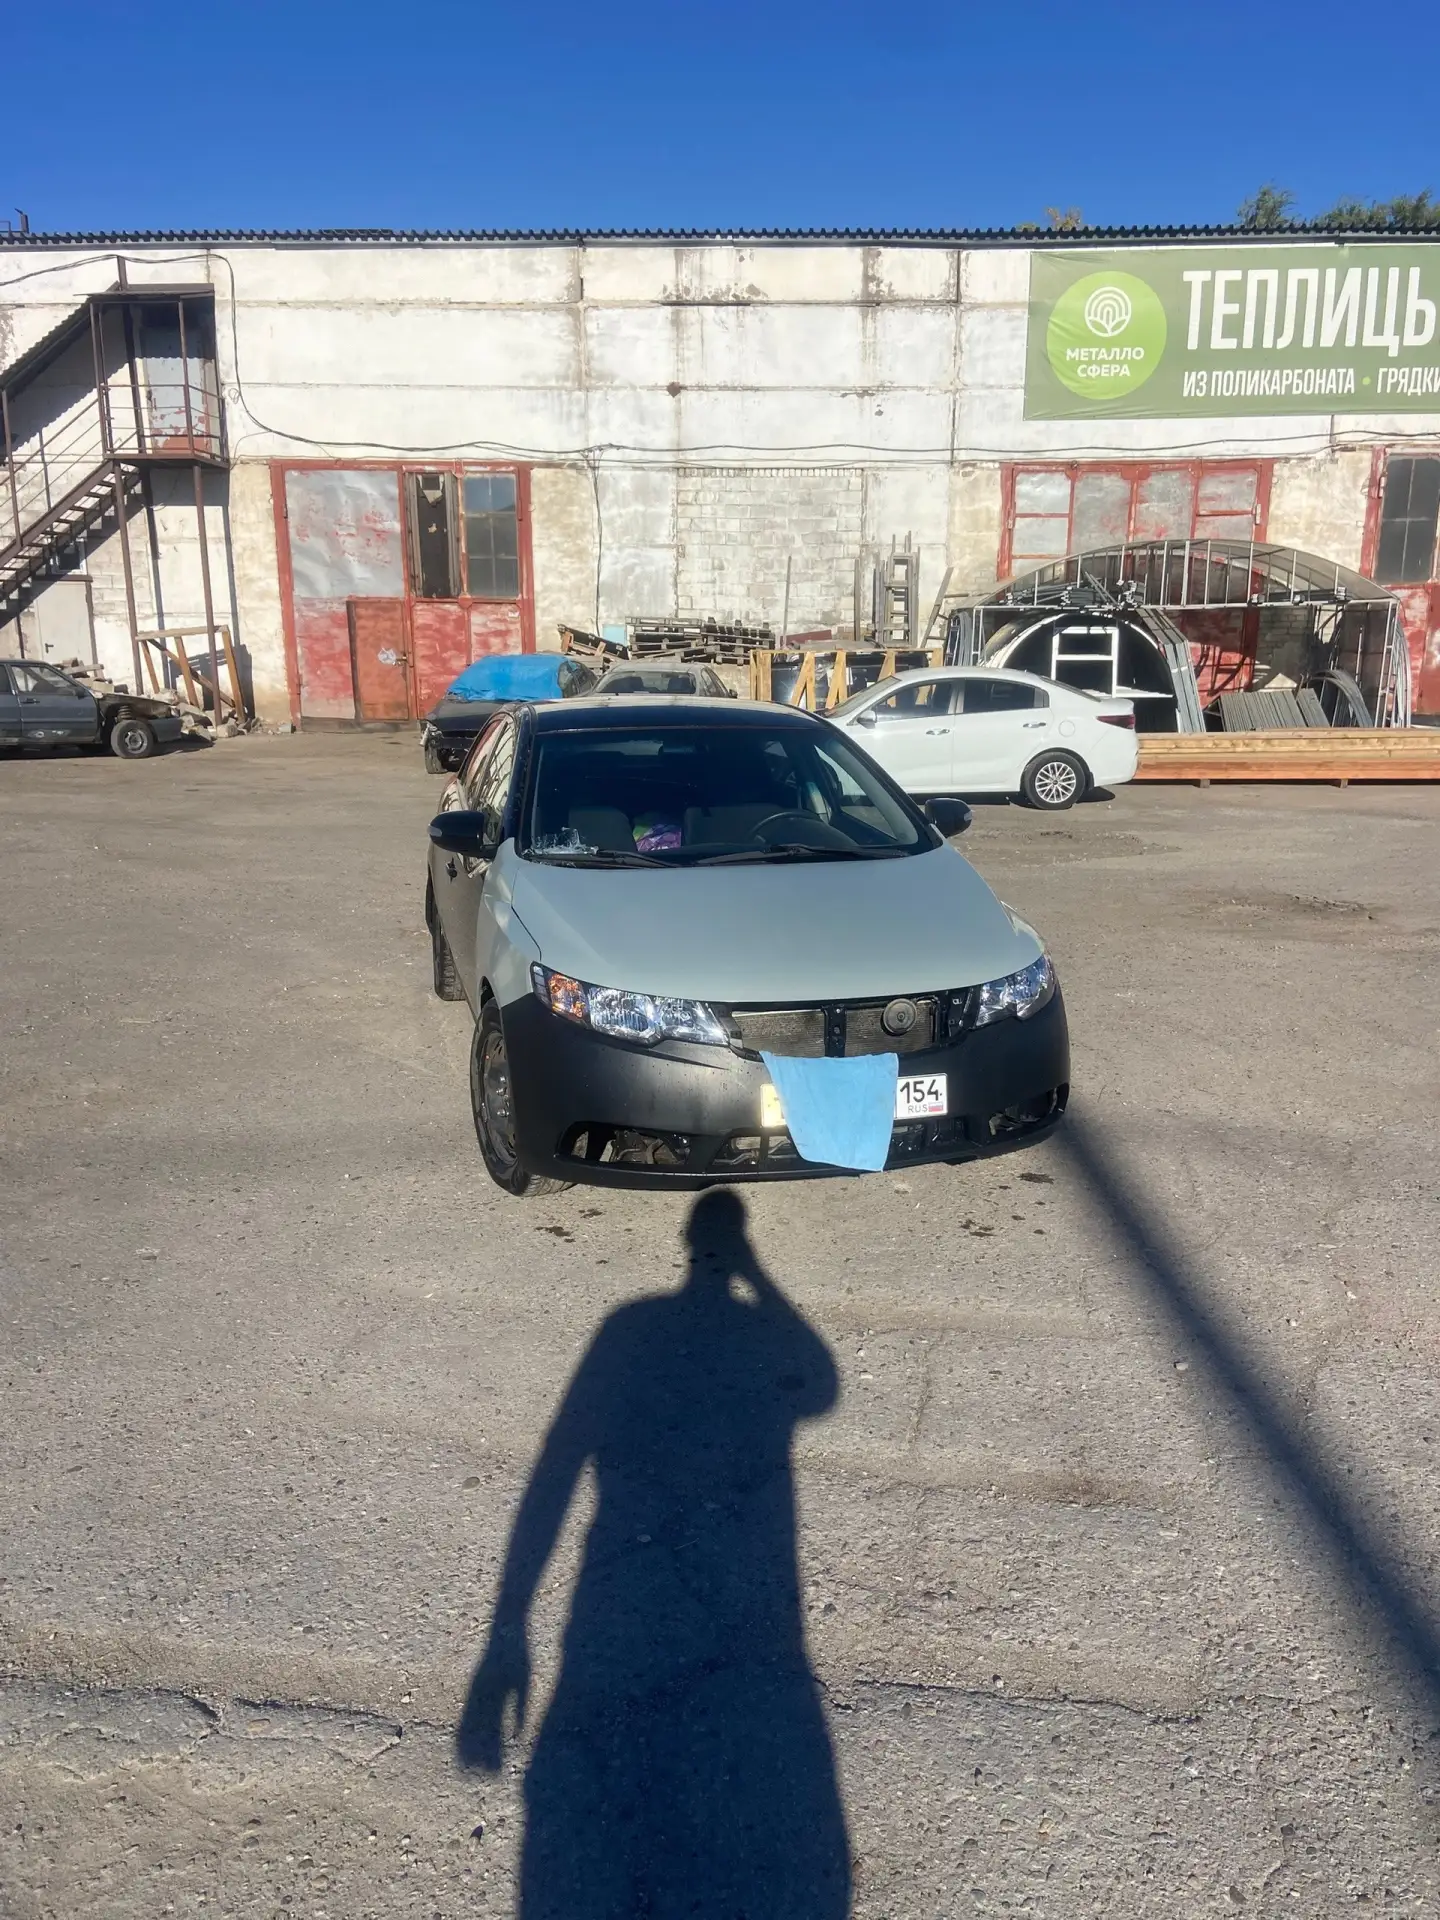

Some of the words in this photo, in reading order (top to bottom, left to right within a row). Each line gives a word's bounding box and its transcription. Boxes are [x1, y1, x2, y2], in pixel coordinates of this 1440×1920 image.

[1066, 347, 1145, 361] МЕТАЛЛО
[1077, 364, 1131, 378] СФЕРА
[1183, 371, 1207, 397] ИЗ
[1210, 368, 1356, 396] ПОЛИКАРБОНАТА
[900, 1079, 939, 1104] 154
[908, 1104, 928, 1113] RUS
